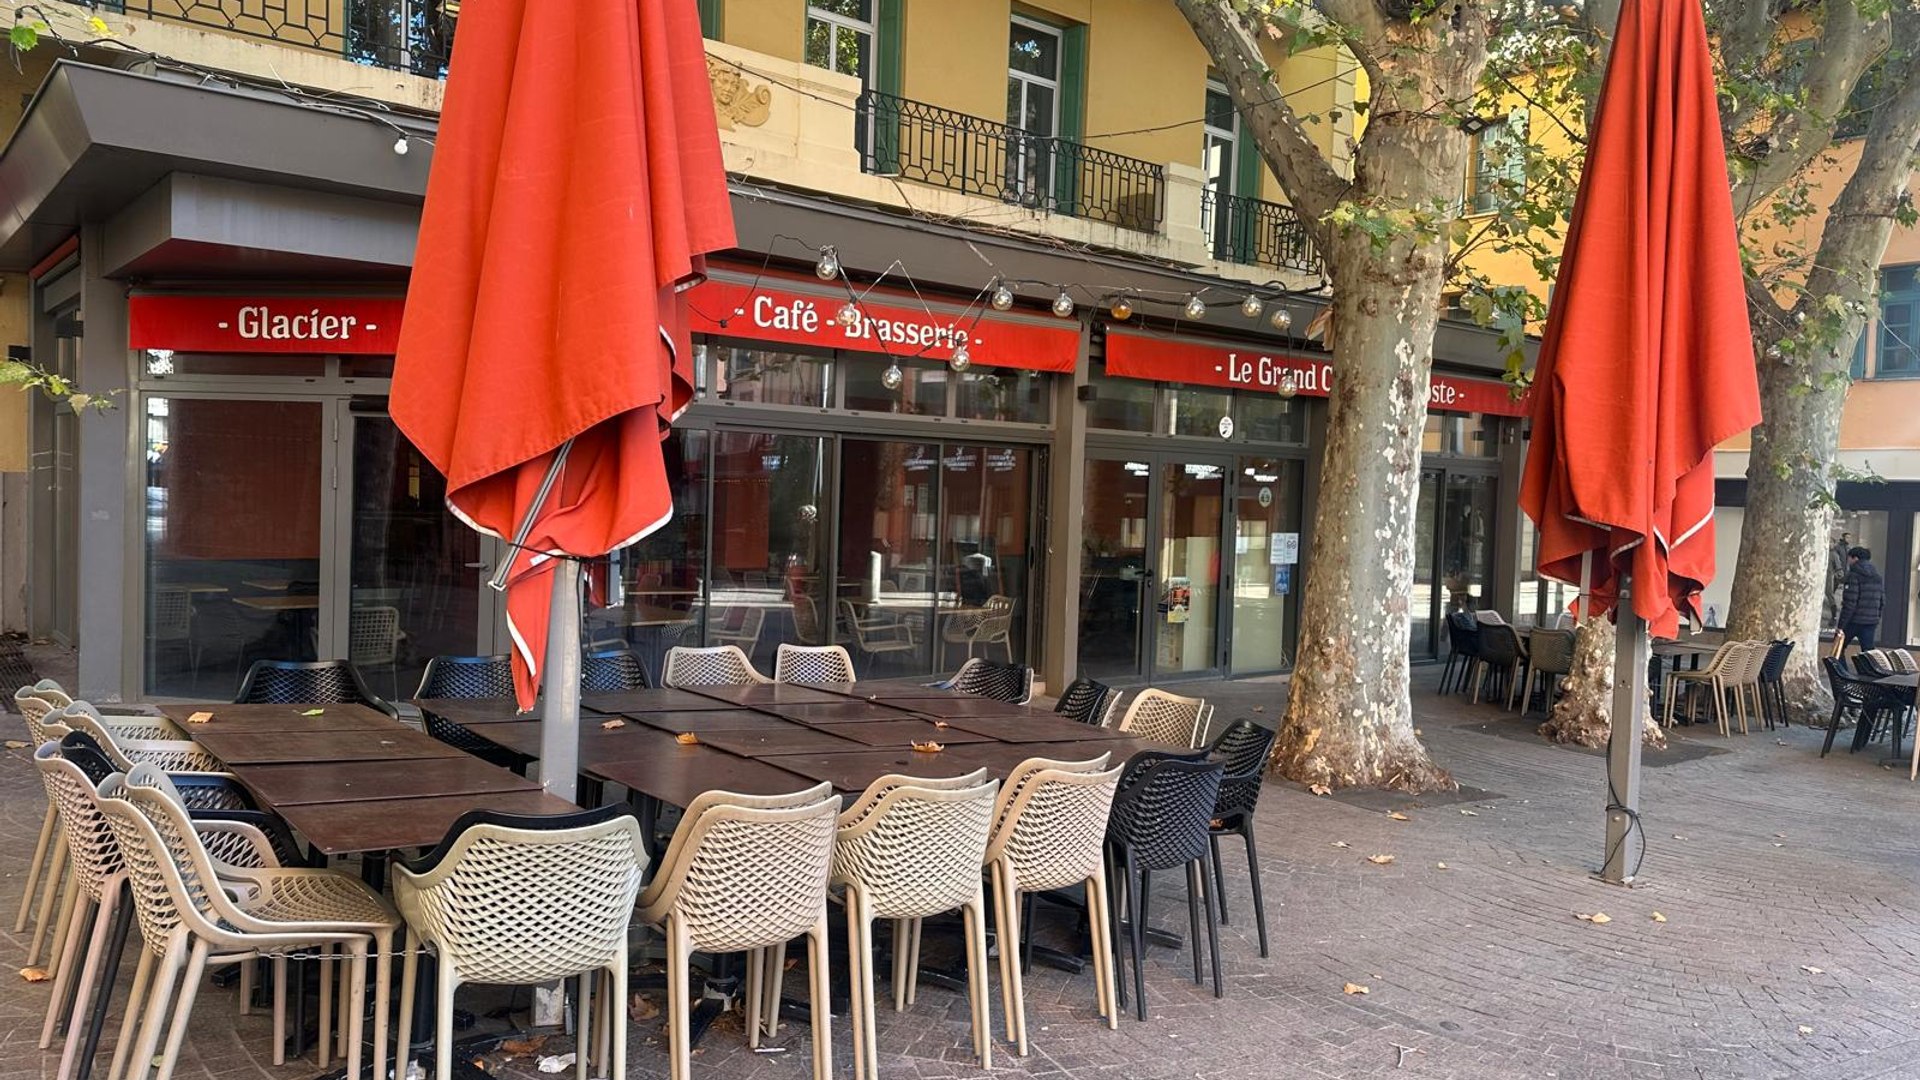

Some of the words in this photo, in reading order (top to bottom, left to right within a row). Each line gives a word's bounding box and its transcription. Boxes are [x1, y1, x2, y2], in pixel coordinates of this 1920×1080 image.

[238, 306, 357, 340] Glacier
[753, 295, 818, 333] Café
[845, 307, 969, 350] Brasserie
[1228, 353, 1253, 383] Le
